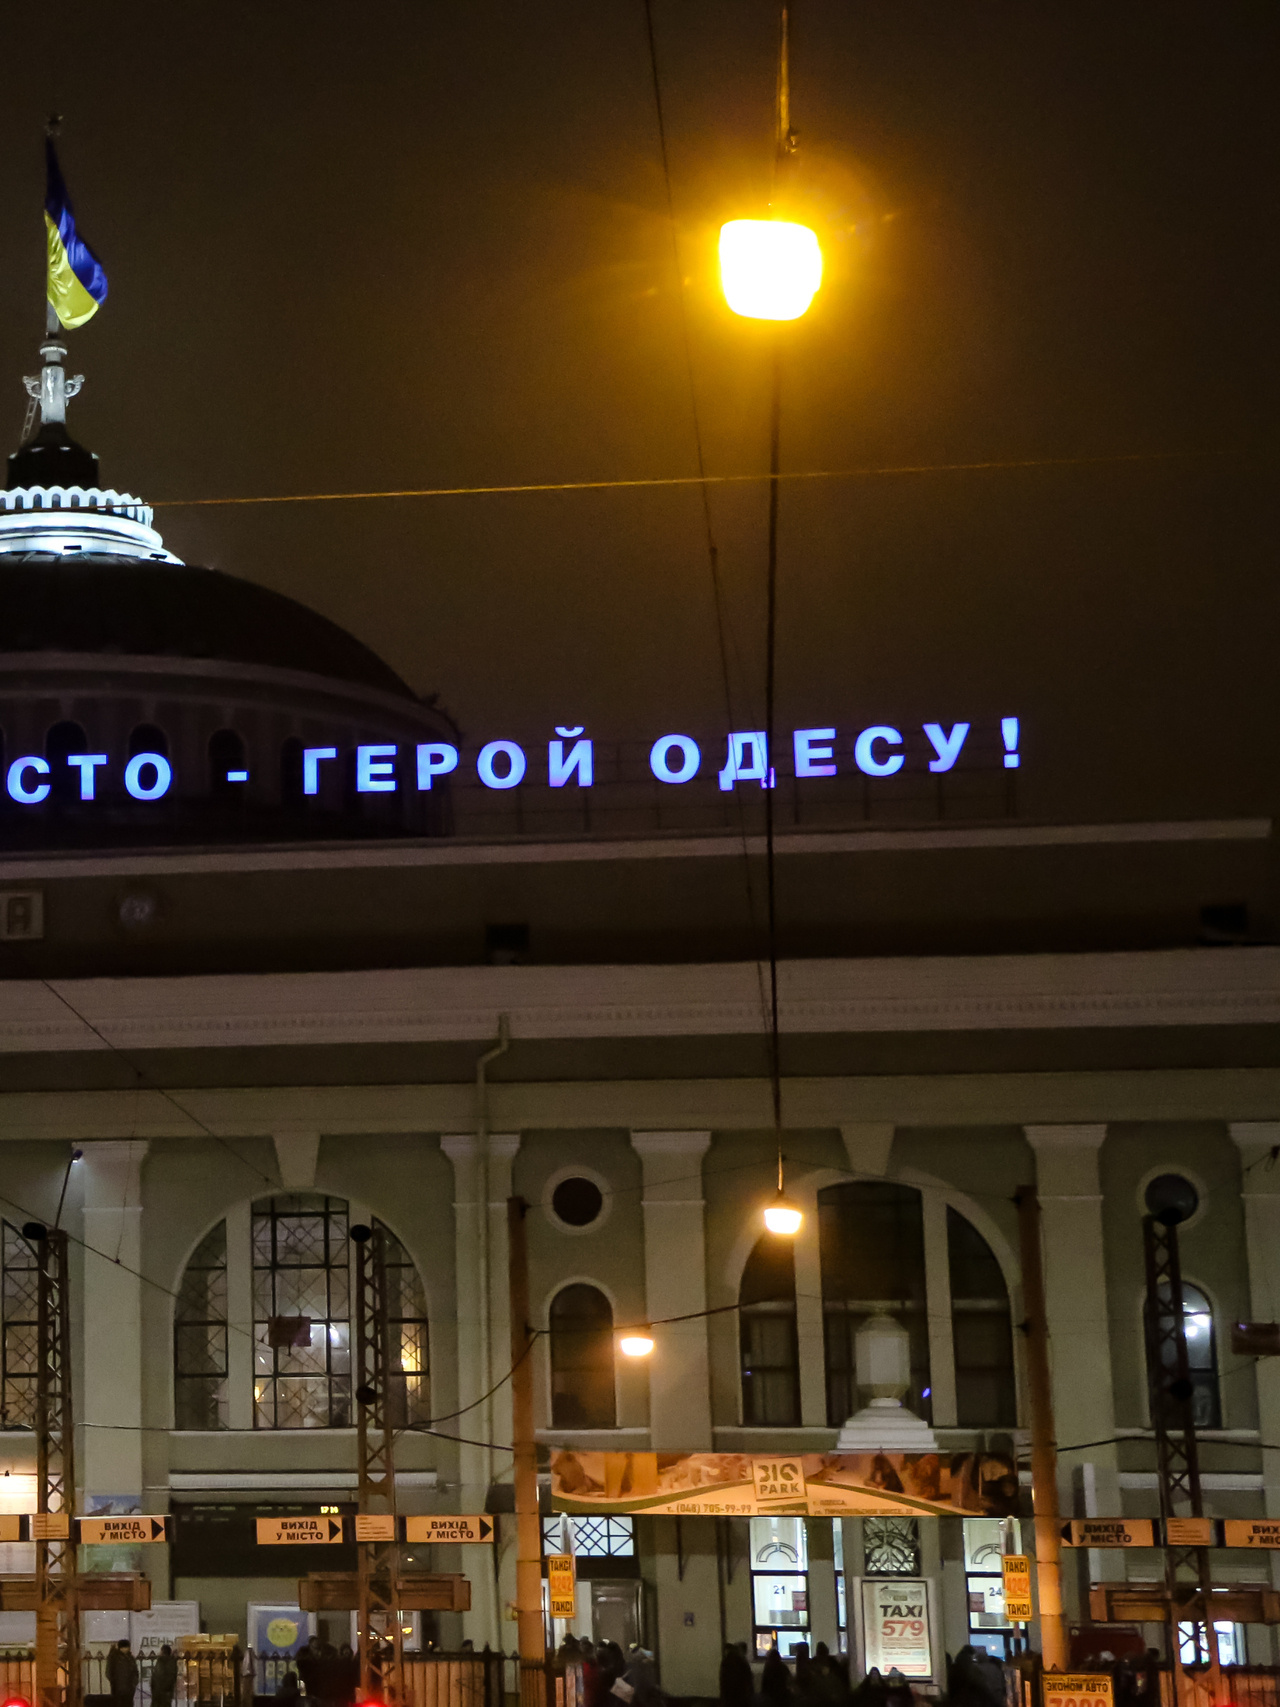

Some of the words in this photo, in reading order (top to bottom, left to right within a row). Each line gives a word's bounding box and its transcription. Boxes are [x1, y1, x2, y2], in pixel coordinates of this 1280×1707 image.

[302, 726, 595, 795] ГЕРОЙ
[760, 1483, 799, 1494] PARK
[104, 1522, 140, 1531] ВИХІД
[281, 1521, 318, 1530] ВИХІД
[431, 1521, 468, 1530] ВИХІД
[1084, 1524, 1125, 1533] ВИХІД
[110, 1531, 146, 1539] МІСТО
[286, 1532, 323, 1540] МІСТО
[436, 1531, 474, 1539] МІСТО
[1090, 1534, 1132, 1543] МІСТО
[773, 1585, 786, 1595] 21
[880, 1605, 923, 1617] TAXI
[881, 1620, 924, 1637] 579
